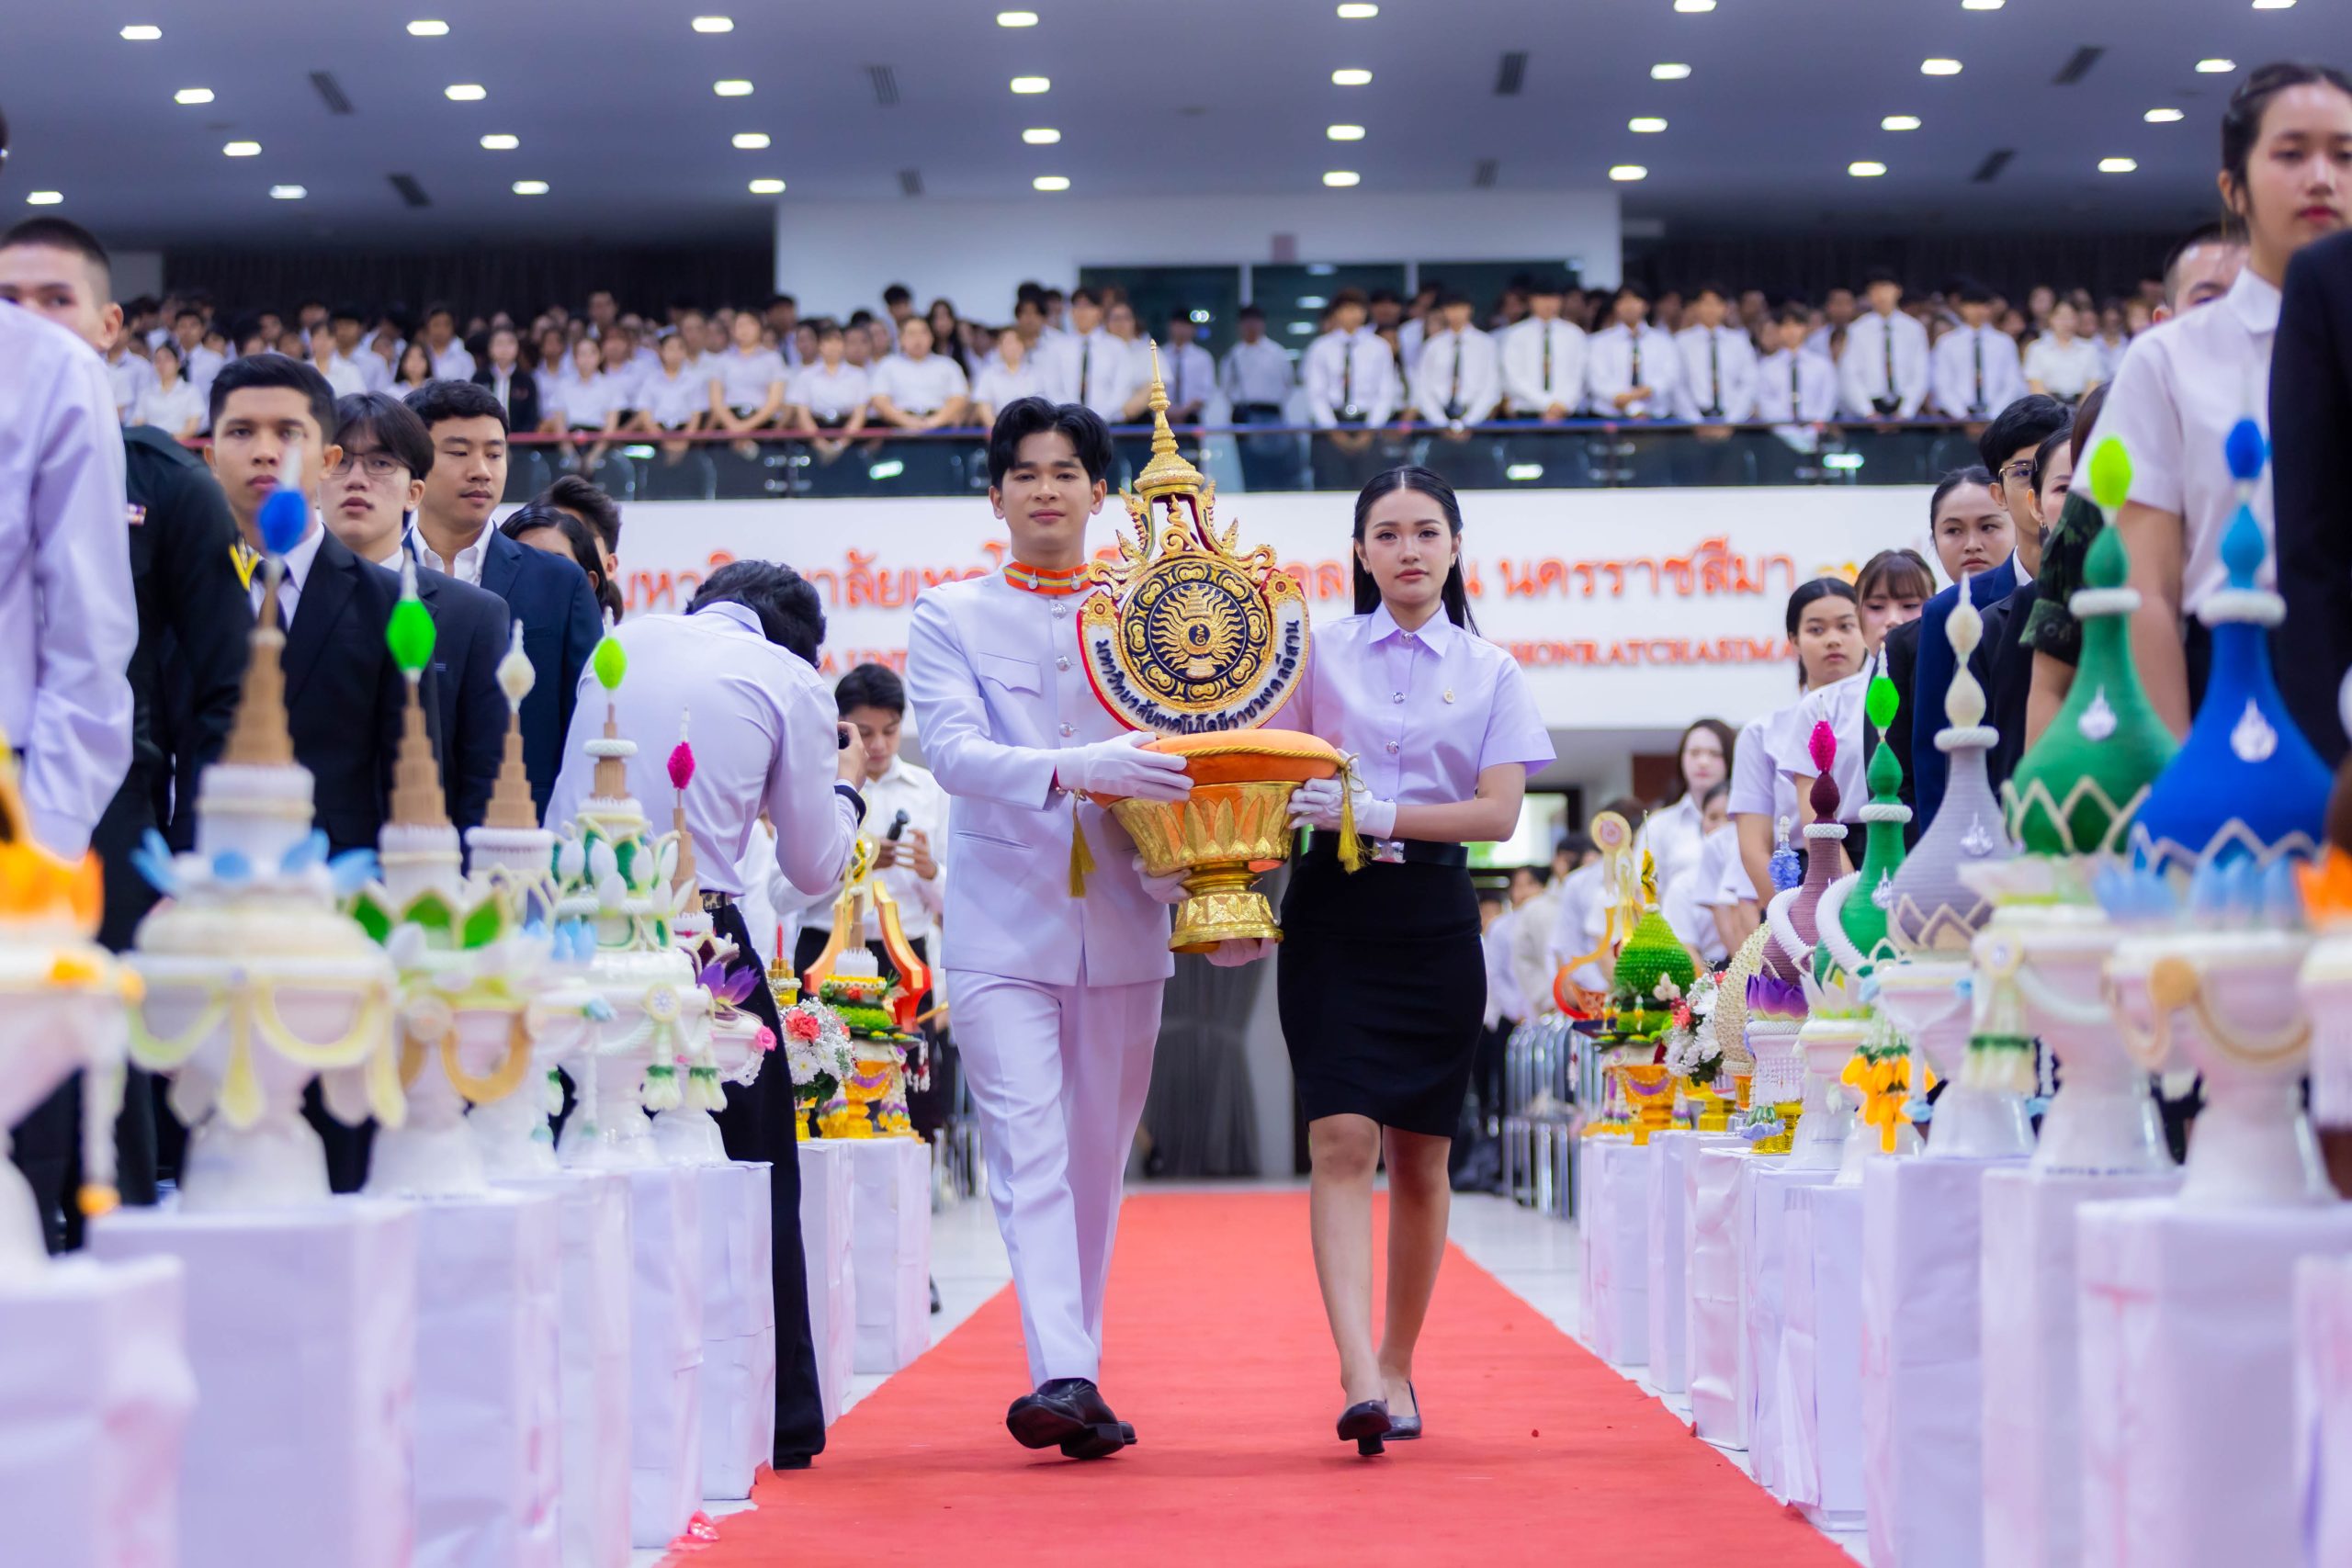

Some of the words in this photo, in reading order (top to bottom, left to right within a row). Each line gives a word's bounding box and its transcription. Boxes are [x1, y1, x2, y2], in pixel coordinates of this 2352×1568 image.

[1498, 536, 1795, 596] นครราชสีมา
[1497, 637, 1798, 666] HONRATCHASIMA
